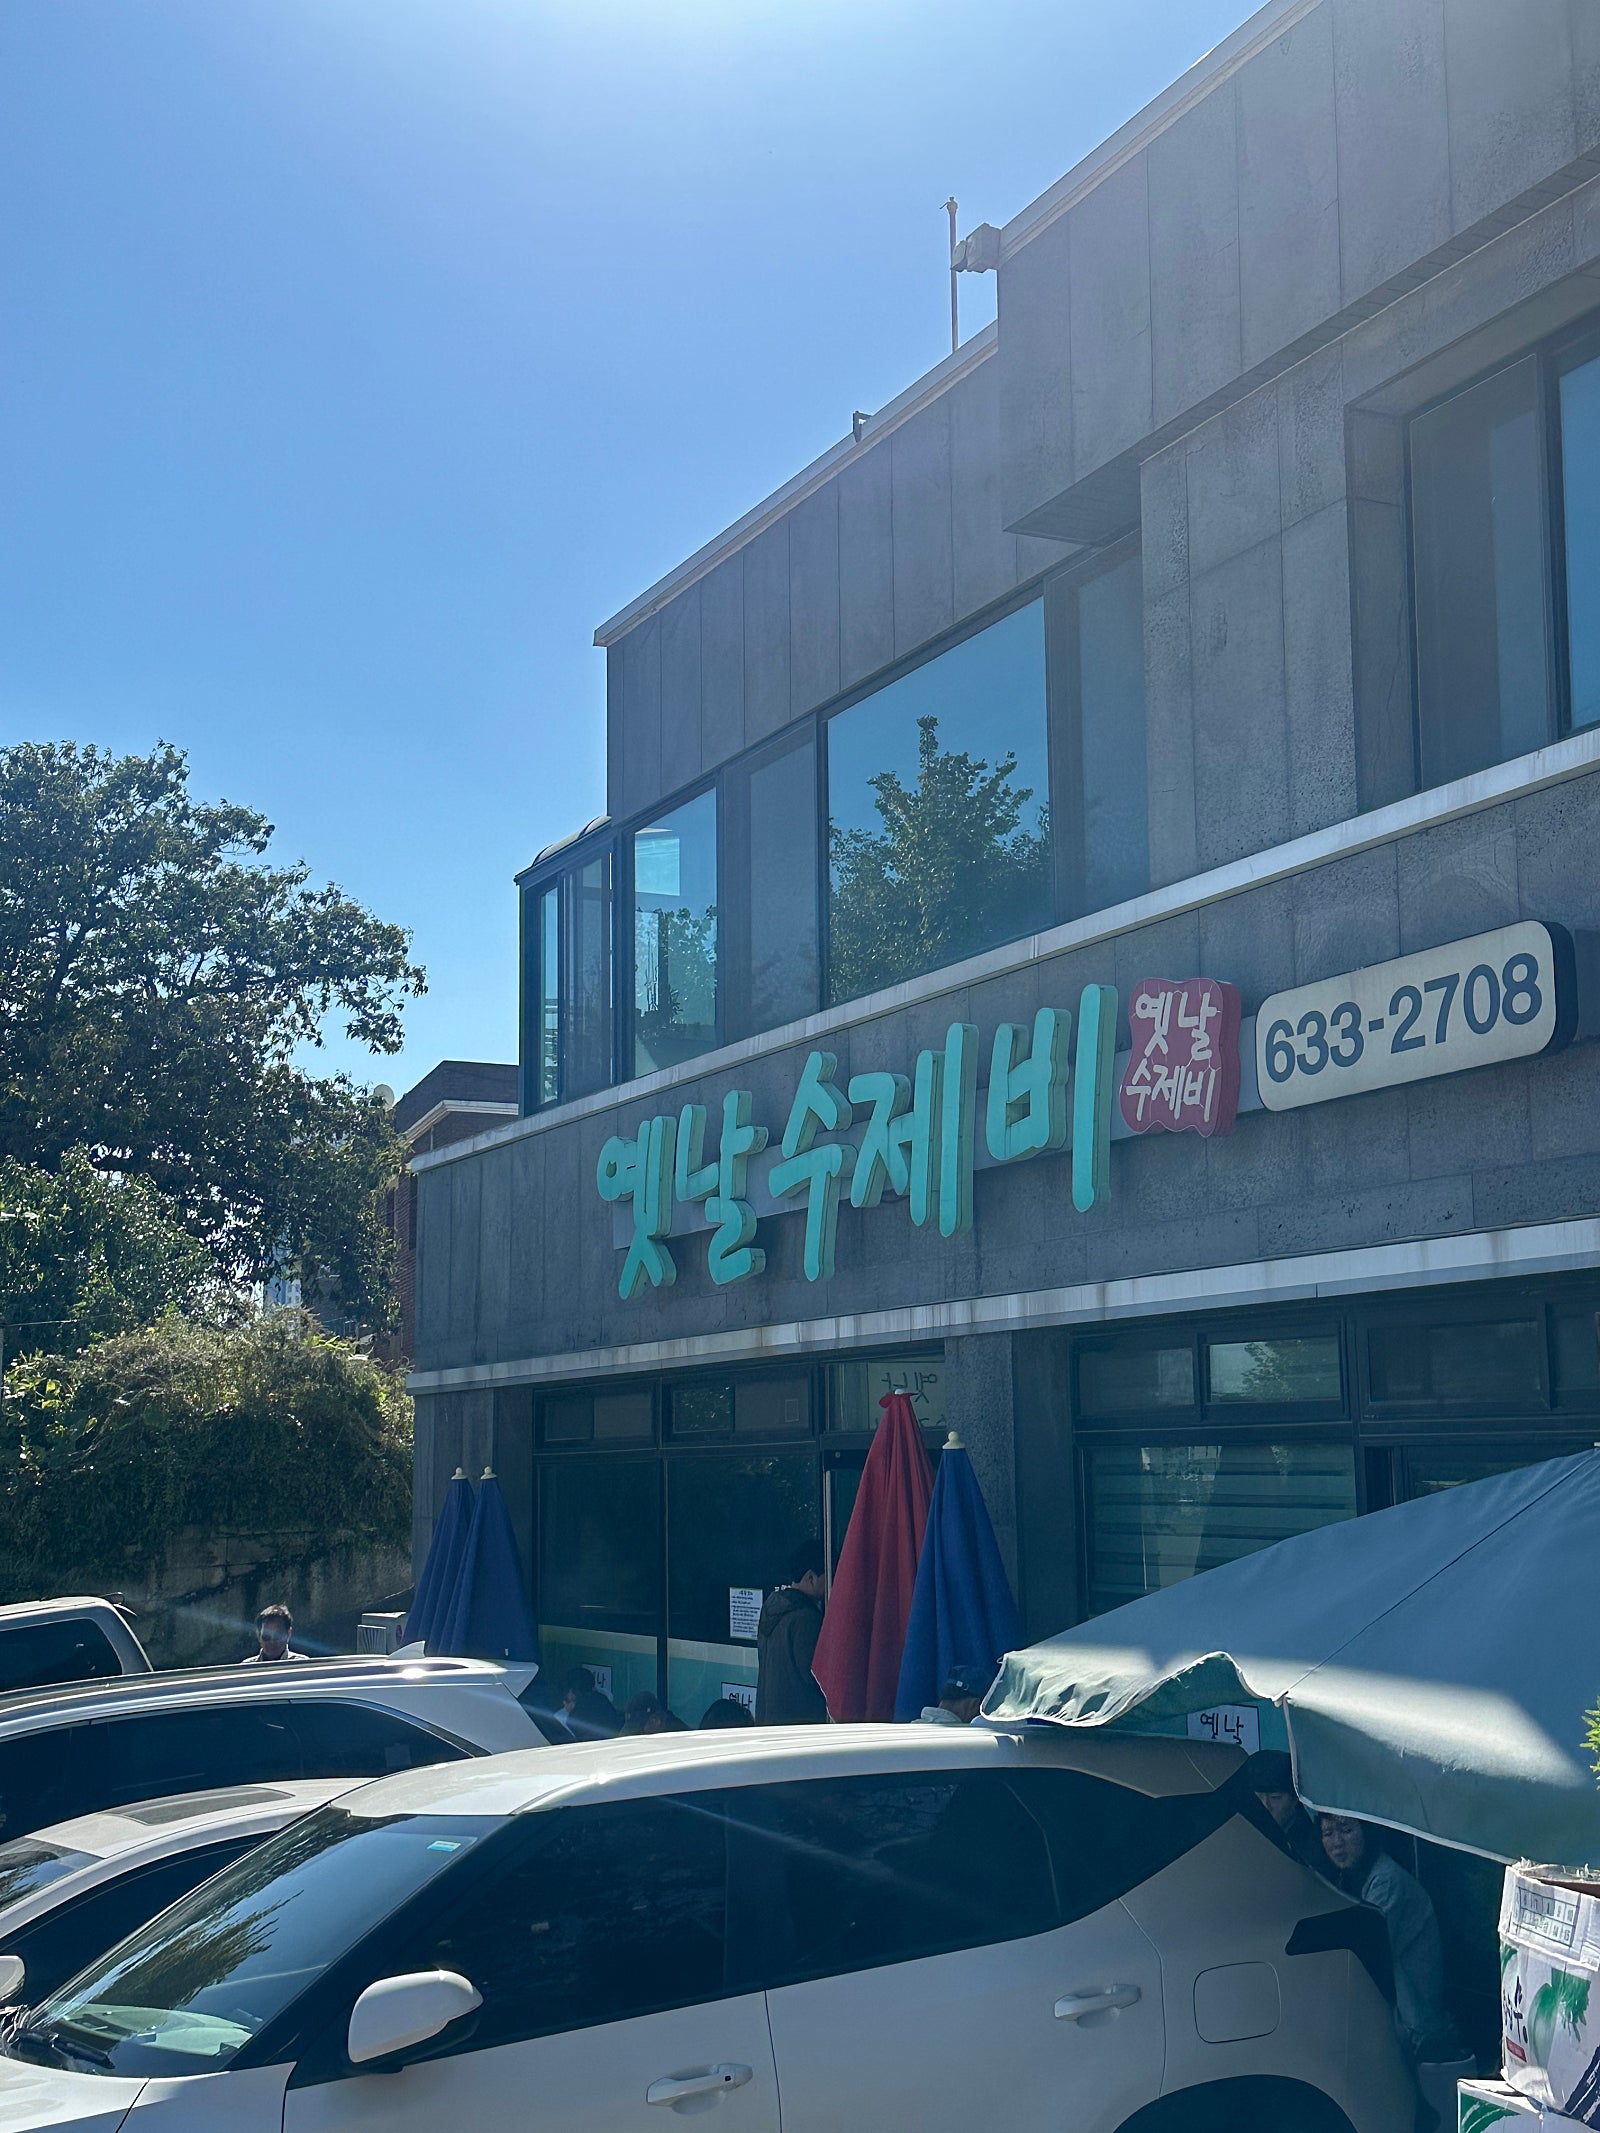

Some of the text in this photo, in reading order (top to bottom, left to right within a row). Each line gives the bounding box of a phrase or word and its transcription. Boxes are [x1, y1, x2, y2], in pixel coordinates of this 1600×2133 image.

[1135, 992, 1218, 1061] 옛날
[1265, 952, 1542, 1083] 633-2708
[1126, 1058, 1217, 1122] 수제비
[597, 984, 1117, 1300] 옛날 수제비
